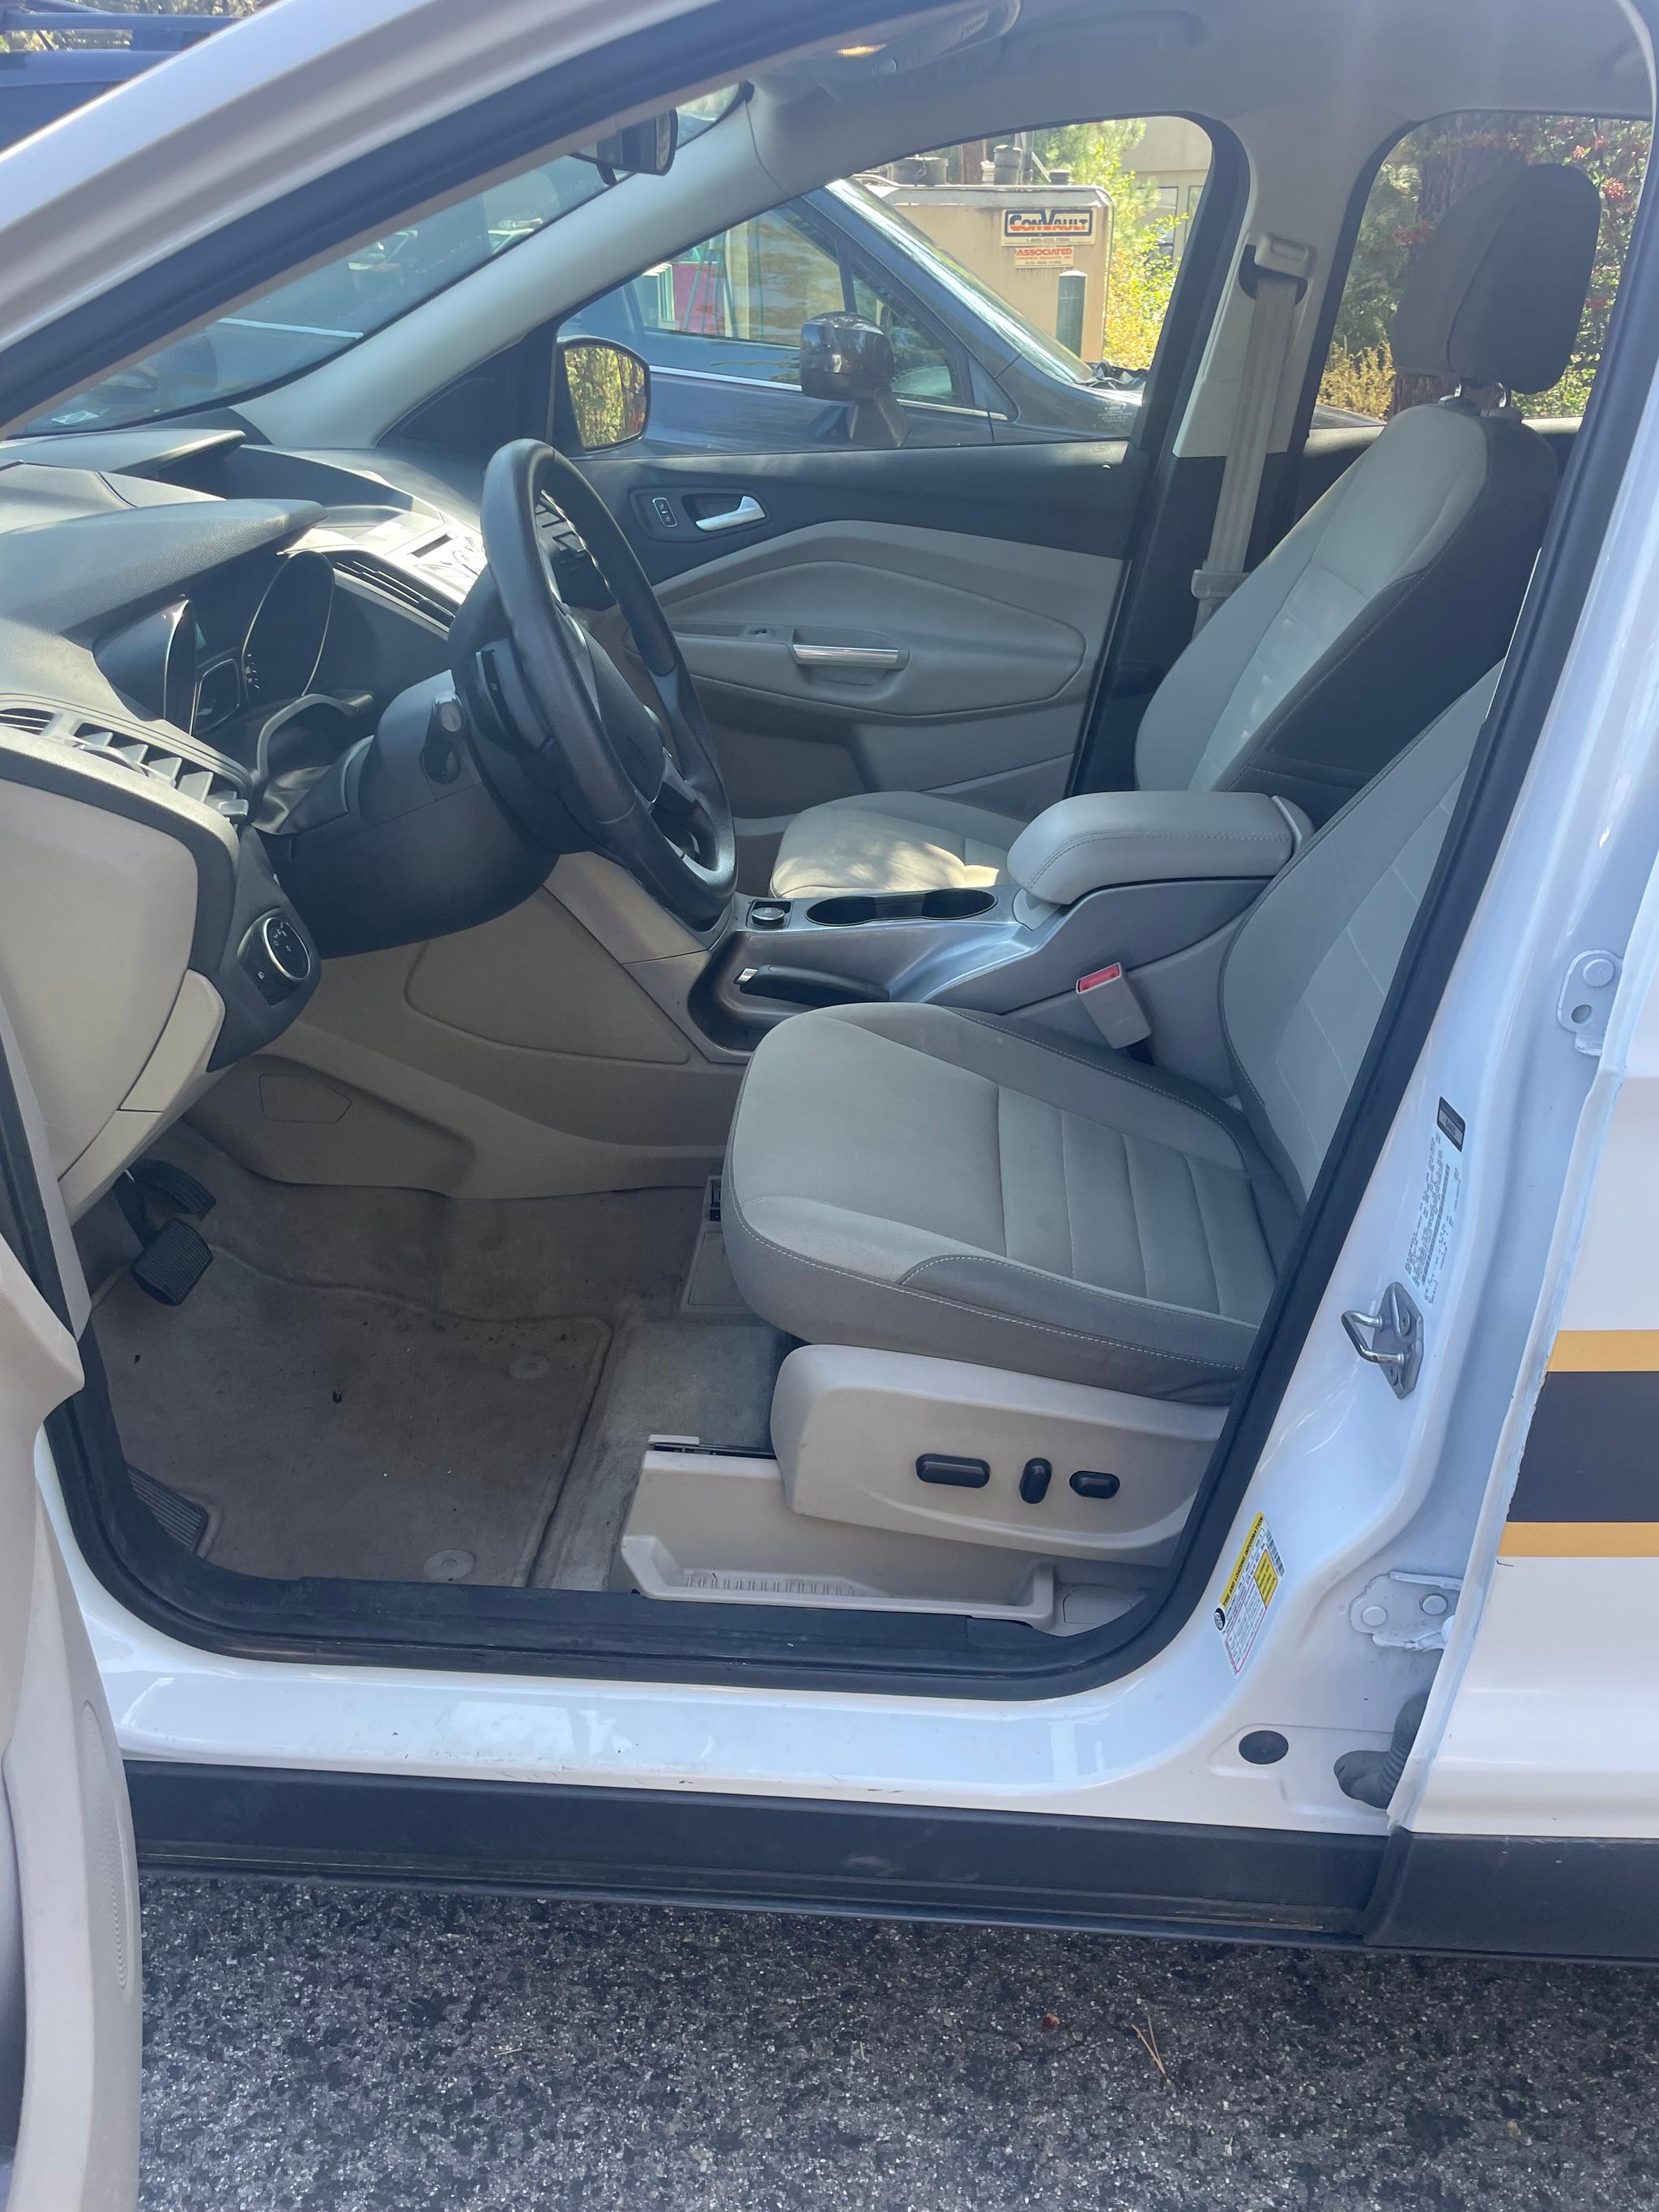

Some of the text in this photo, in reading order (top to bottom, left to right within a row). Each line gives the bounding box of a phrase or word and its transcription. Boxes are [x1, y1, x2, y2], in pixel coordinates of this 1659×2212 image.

[1017, 248, 1073, 256] ASSOCIATED
[1222, 1593, 1230, 1607] TIRE
[1235, 1556, 1246, 1582] LOADING
[1244, 1516, 1263, 1556] INFORMATION
